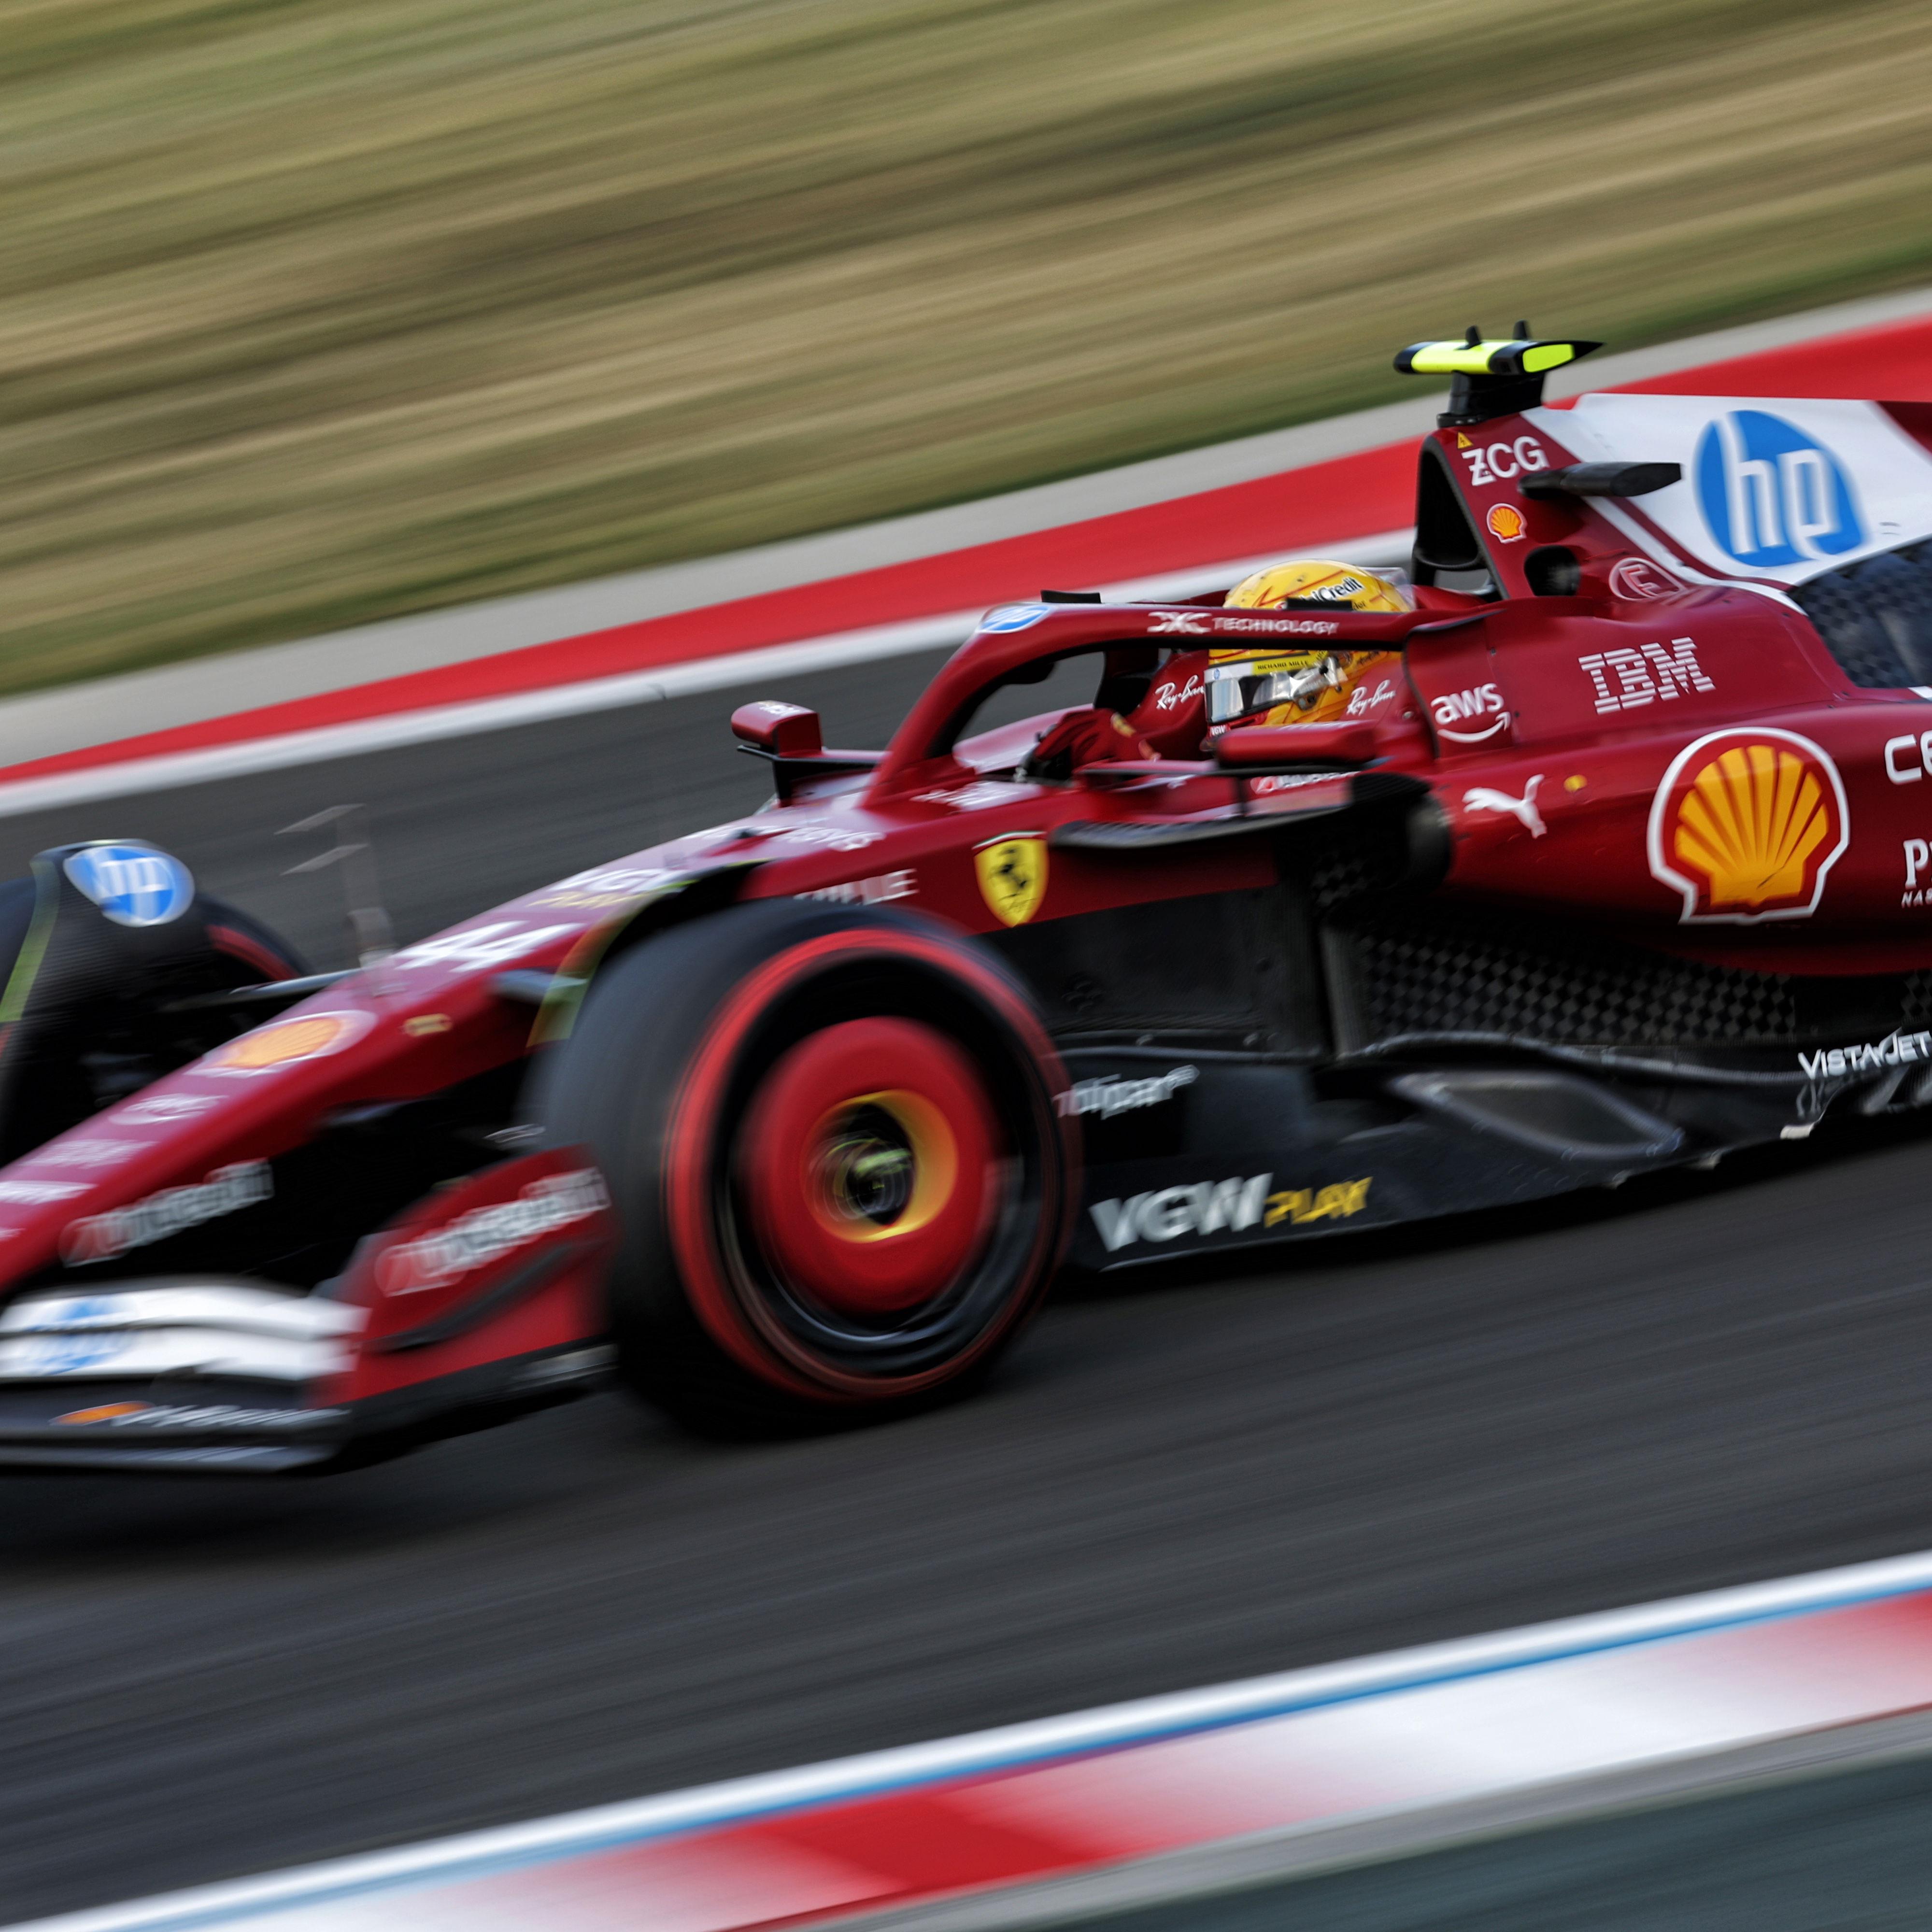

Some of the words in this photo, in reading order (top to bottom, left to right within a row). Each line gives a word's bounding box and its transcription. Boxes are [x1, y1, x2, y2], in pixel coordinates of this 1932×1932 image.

[1462, 436, 1549, 486] ZCG
[1713, 413, 1842, 561] hp
[1300, 577, 1364, 602] iCredit
[1212, 617, 1340, 635] TECHNOLOGY
[1257, 661, 1287, 670] RICHARD
[1578, 637, 1717, 715] IBM
[1155, 675, 1206, 711] Ray-Ban
[1346, 679, 1396, 716] Ray-Ban
[1431, 682, 1504, 725] aws
[1903, 838, 1932, 889] P
[1798, 1030, 1932, 1080] VISTAJET
[1088, 1172, 1274, 1253] VGW
[1264, 1176, 1373, 1228] PLAY
